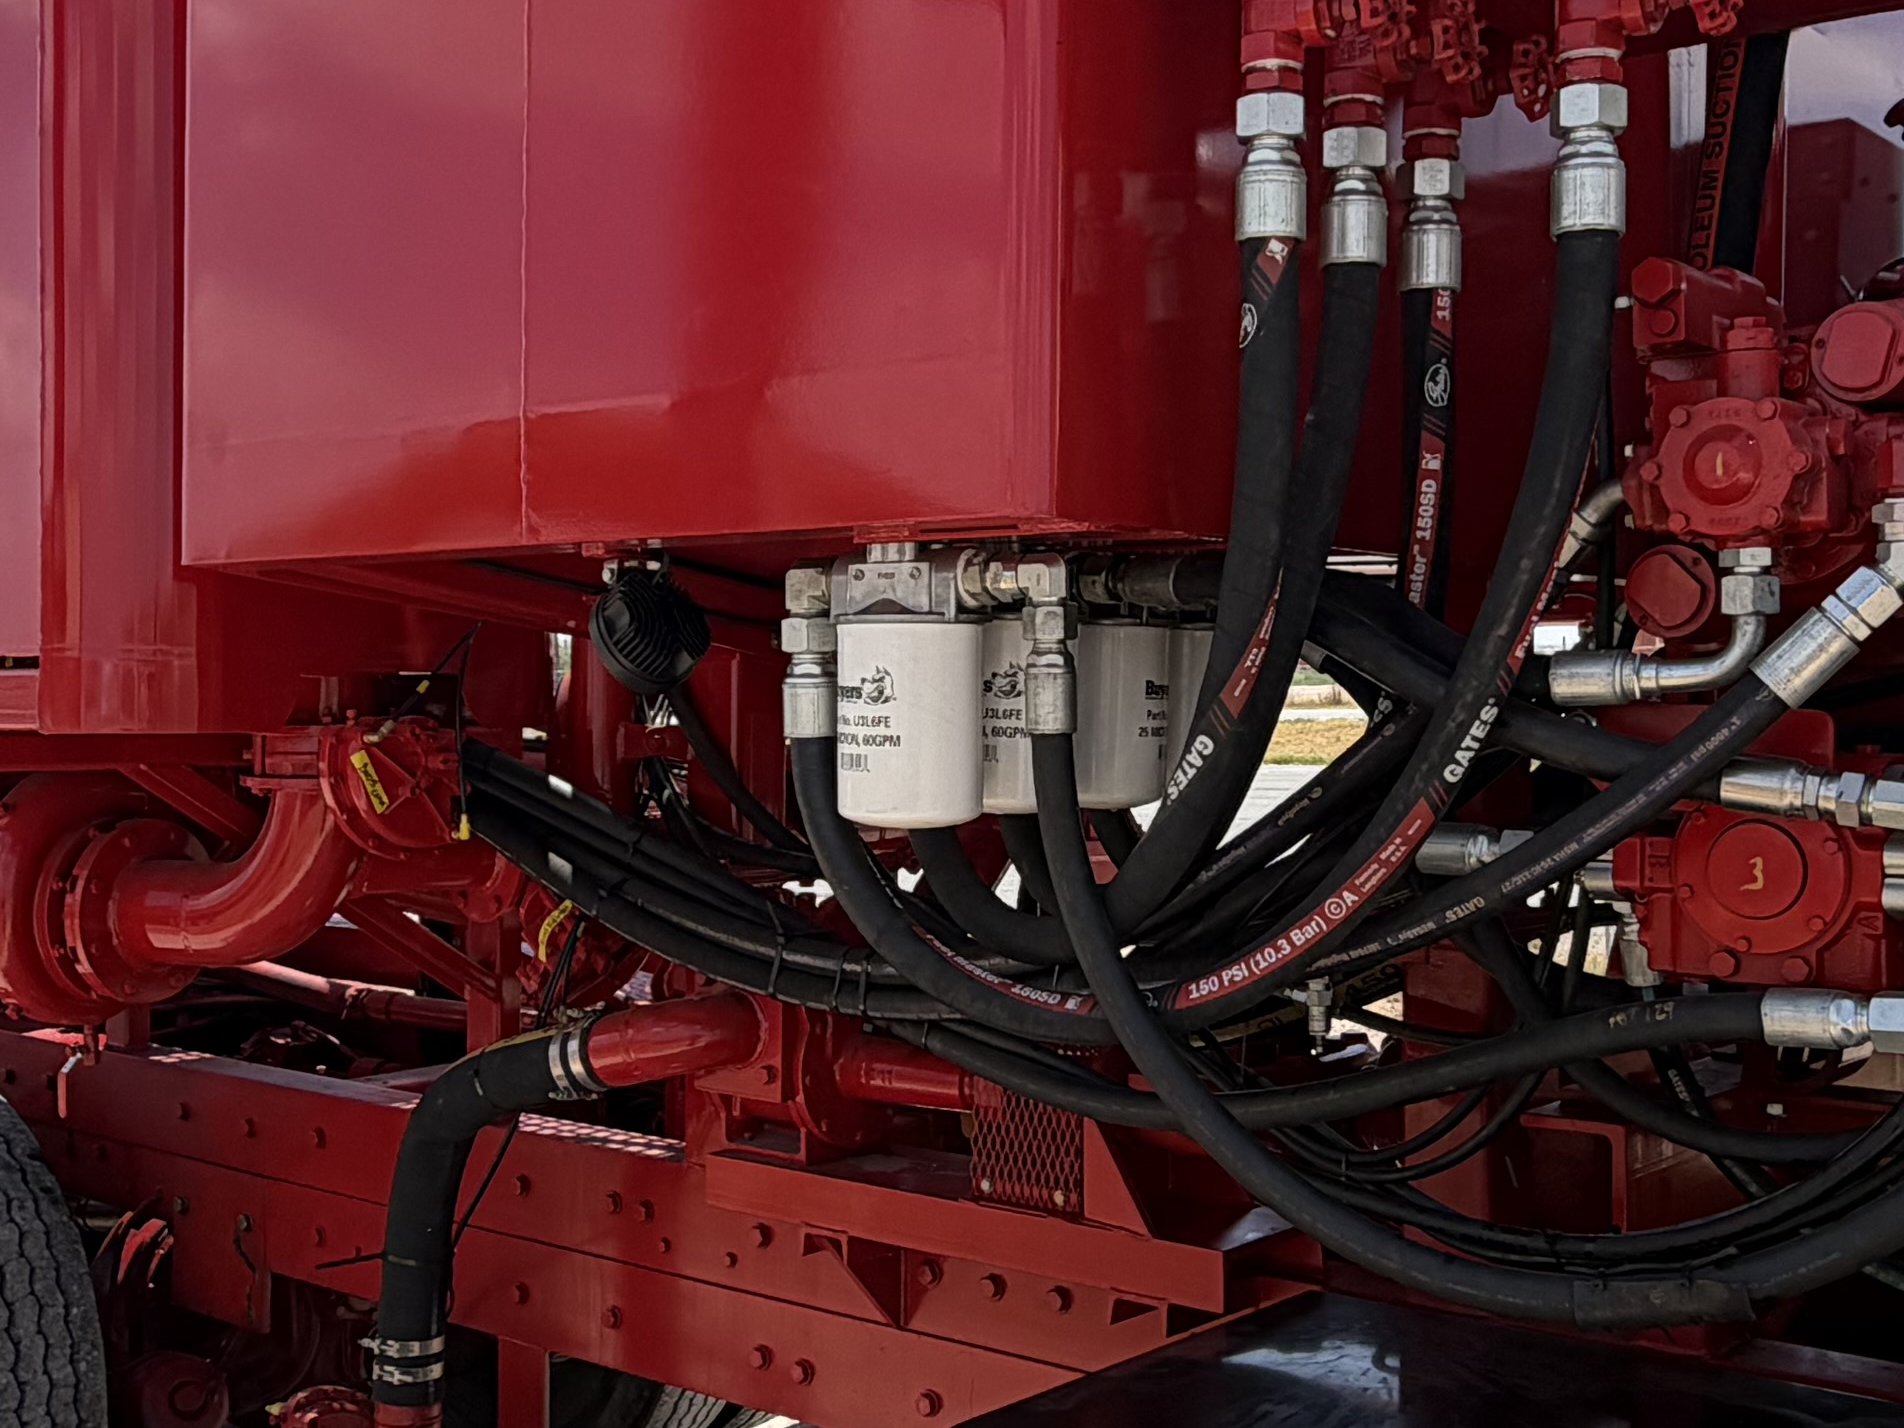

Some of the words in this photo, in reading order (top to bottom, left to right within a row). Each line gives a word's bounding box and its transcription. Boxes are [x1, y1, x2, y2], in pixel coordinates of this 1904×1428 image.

[1690, 169, 1720, 271] OLEUM
[1715, 451, 1724, 477] 1
[1416, 478, 1437, 540] 150SD
[1167, 734, 1216, 801] GATES
[1443, 702, 1499, 784] GATES
[1739, 856, 1764, 891] 3
[1445, 895, 1487, 924] GATES
[1188, 975, 1220, 1000] 150
[1222, 963, 1249, 987] PSI
[1250, 941, 1292, 975] (10.3
[1289, 915, 1328, 947] Bar)
